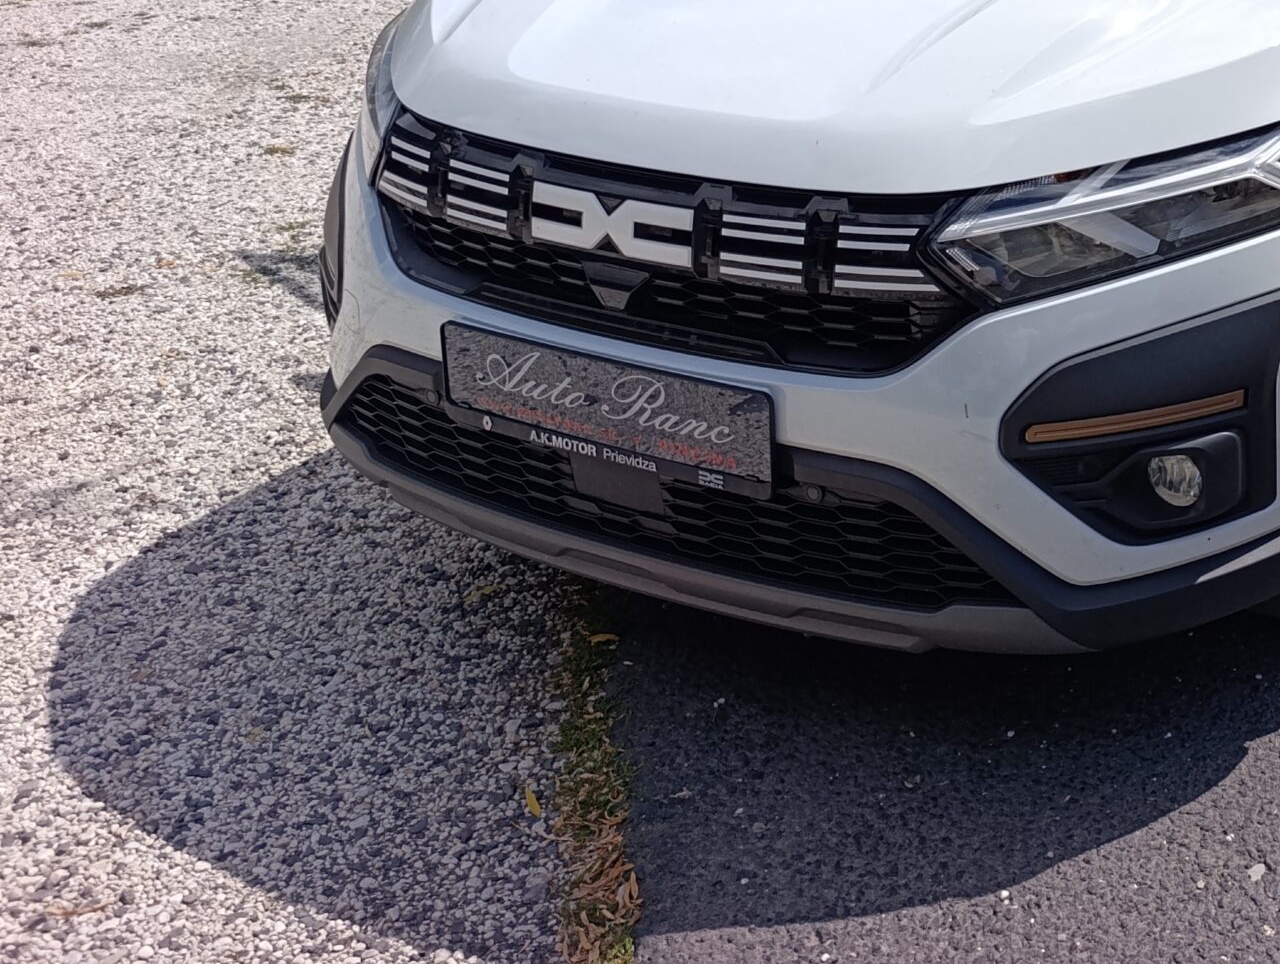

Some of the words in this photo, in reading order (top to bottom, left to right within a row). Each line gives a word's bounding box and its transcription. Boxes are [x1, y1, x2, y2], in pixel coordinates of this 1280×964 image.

[475, 351, 590, 408] Auto
[601, 375, 734, 444] Ranc
[530, 429, 597, 457] A.K.MOTOR
[603, 447, 657, 472] Prievidza
